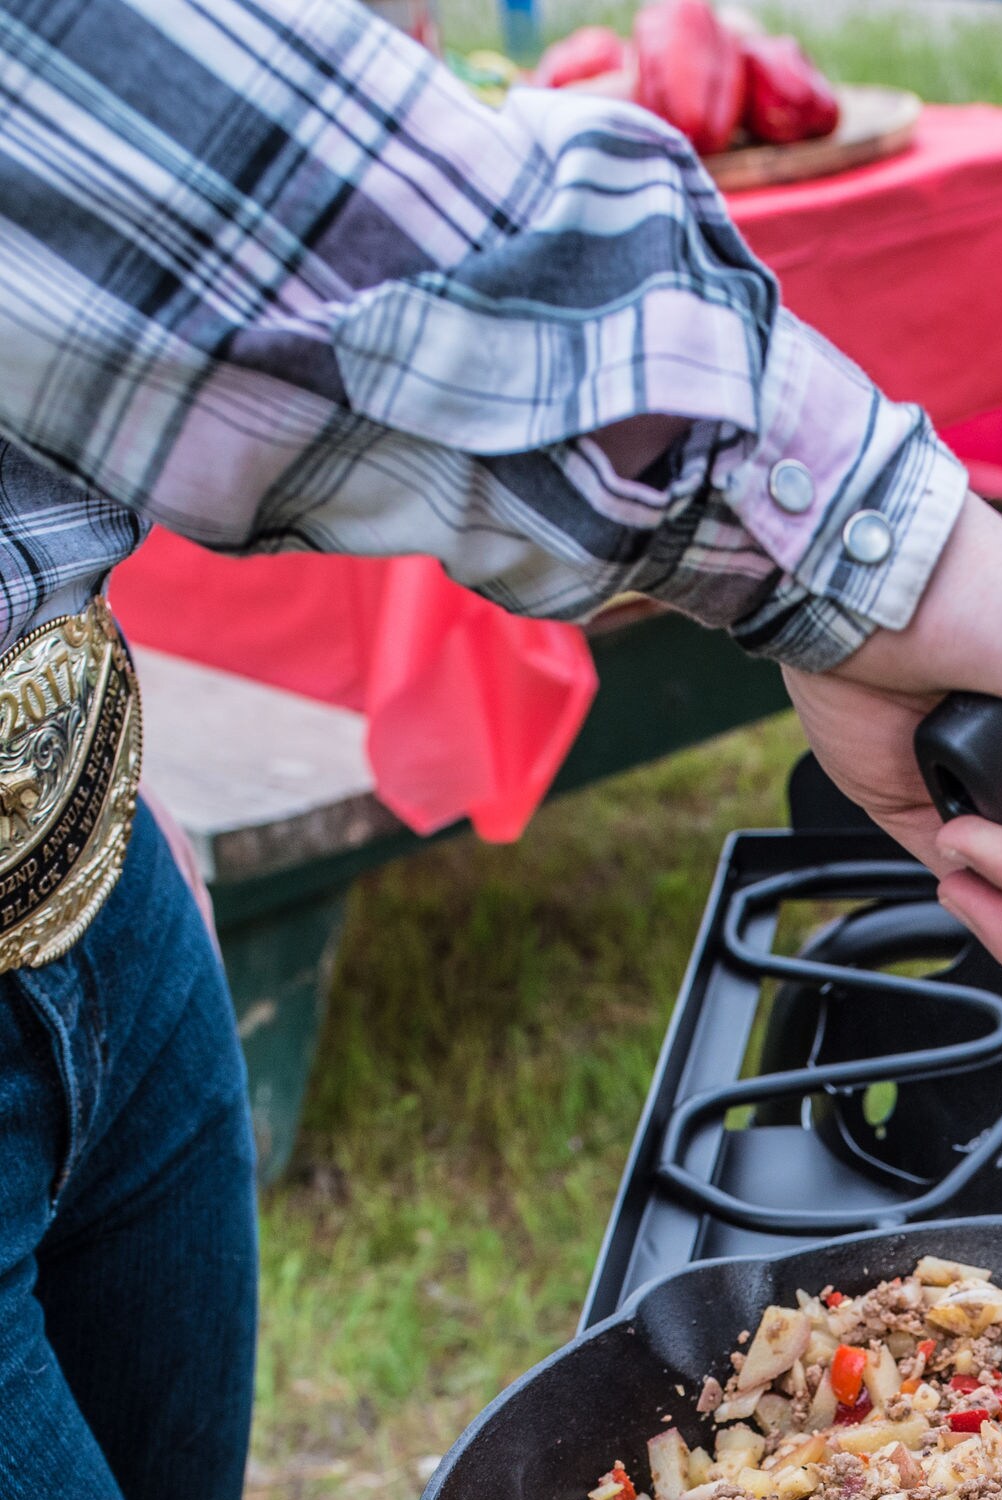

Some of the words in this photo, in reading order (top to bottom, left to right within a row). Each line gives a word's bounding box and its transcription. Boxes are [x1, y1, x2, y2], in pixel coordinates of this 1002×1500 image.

[0, 651, 76, 738] 2017
[1, 862, 62, 926] BLACK
[66, 842, 80, 862] &
[79, 756, 112, 834] WHITE
[42, 786, 90, 862] ANNUAL
